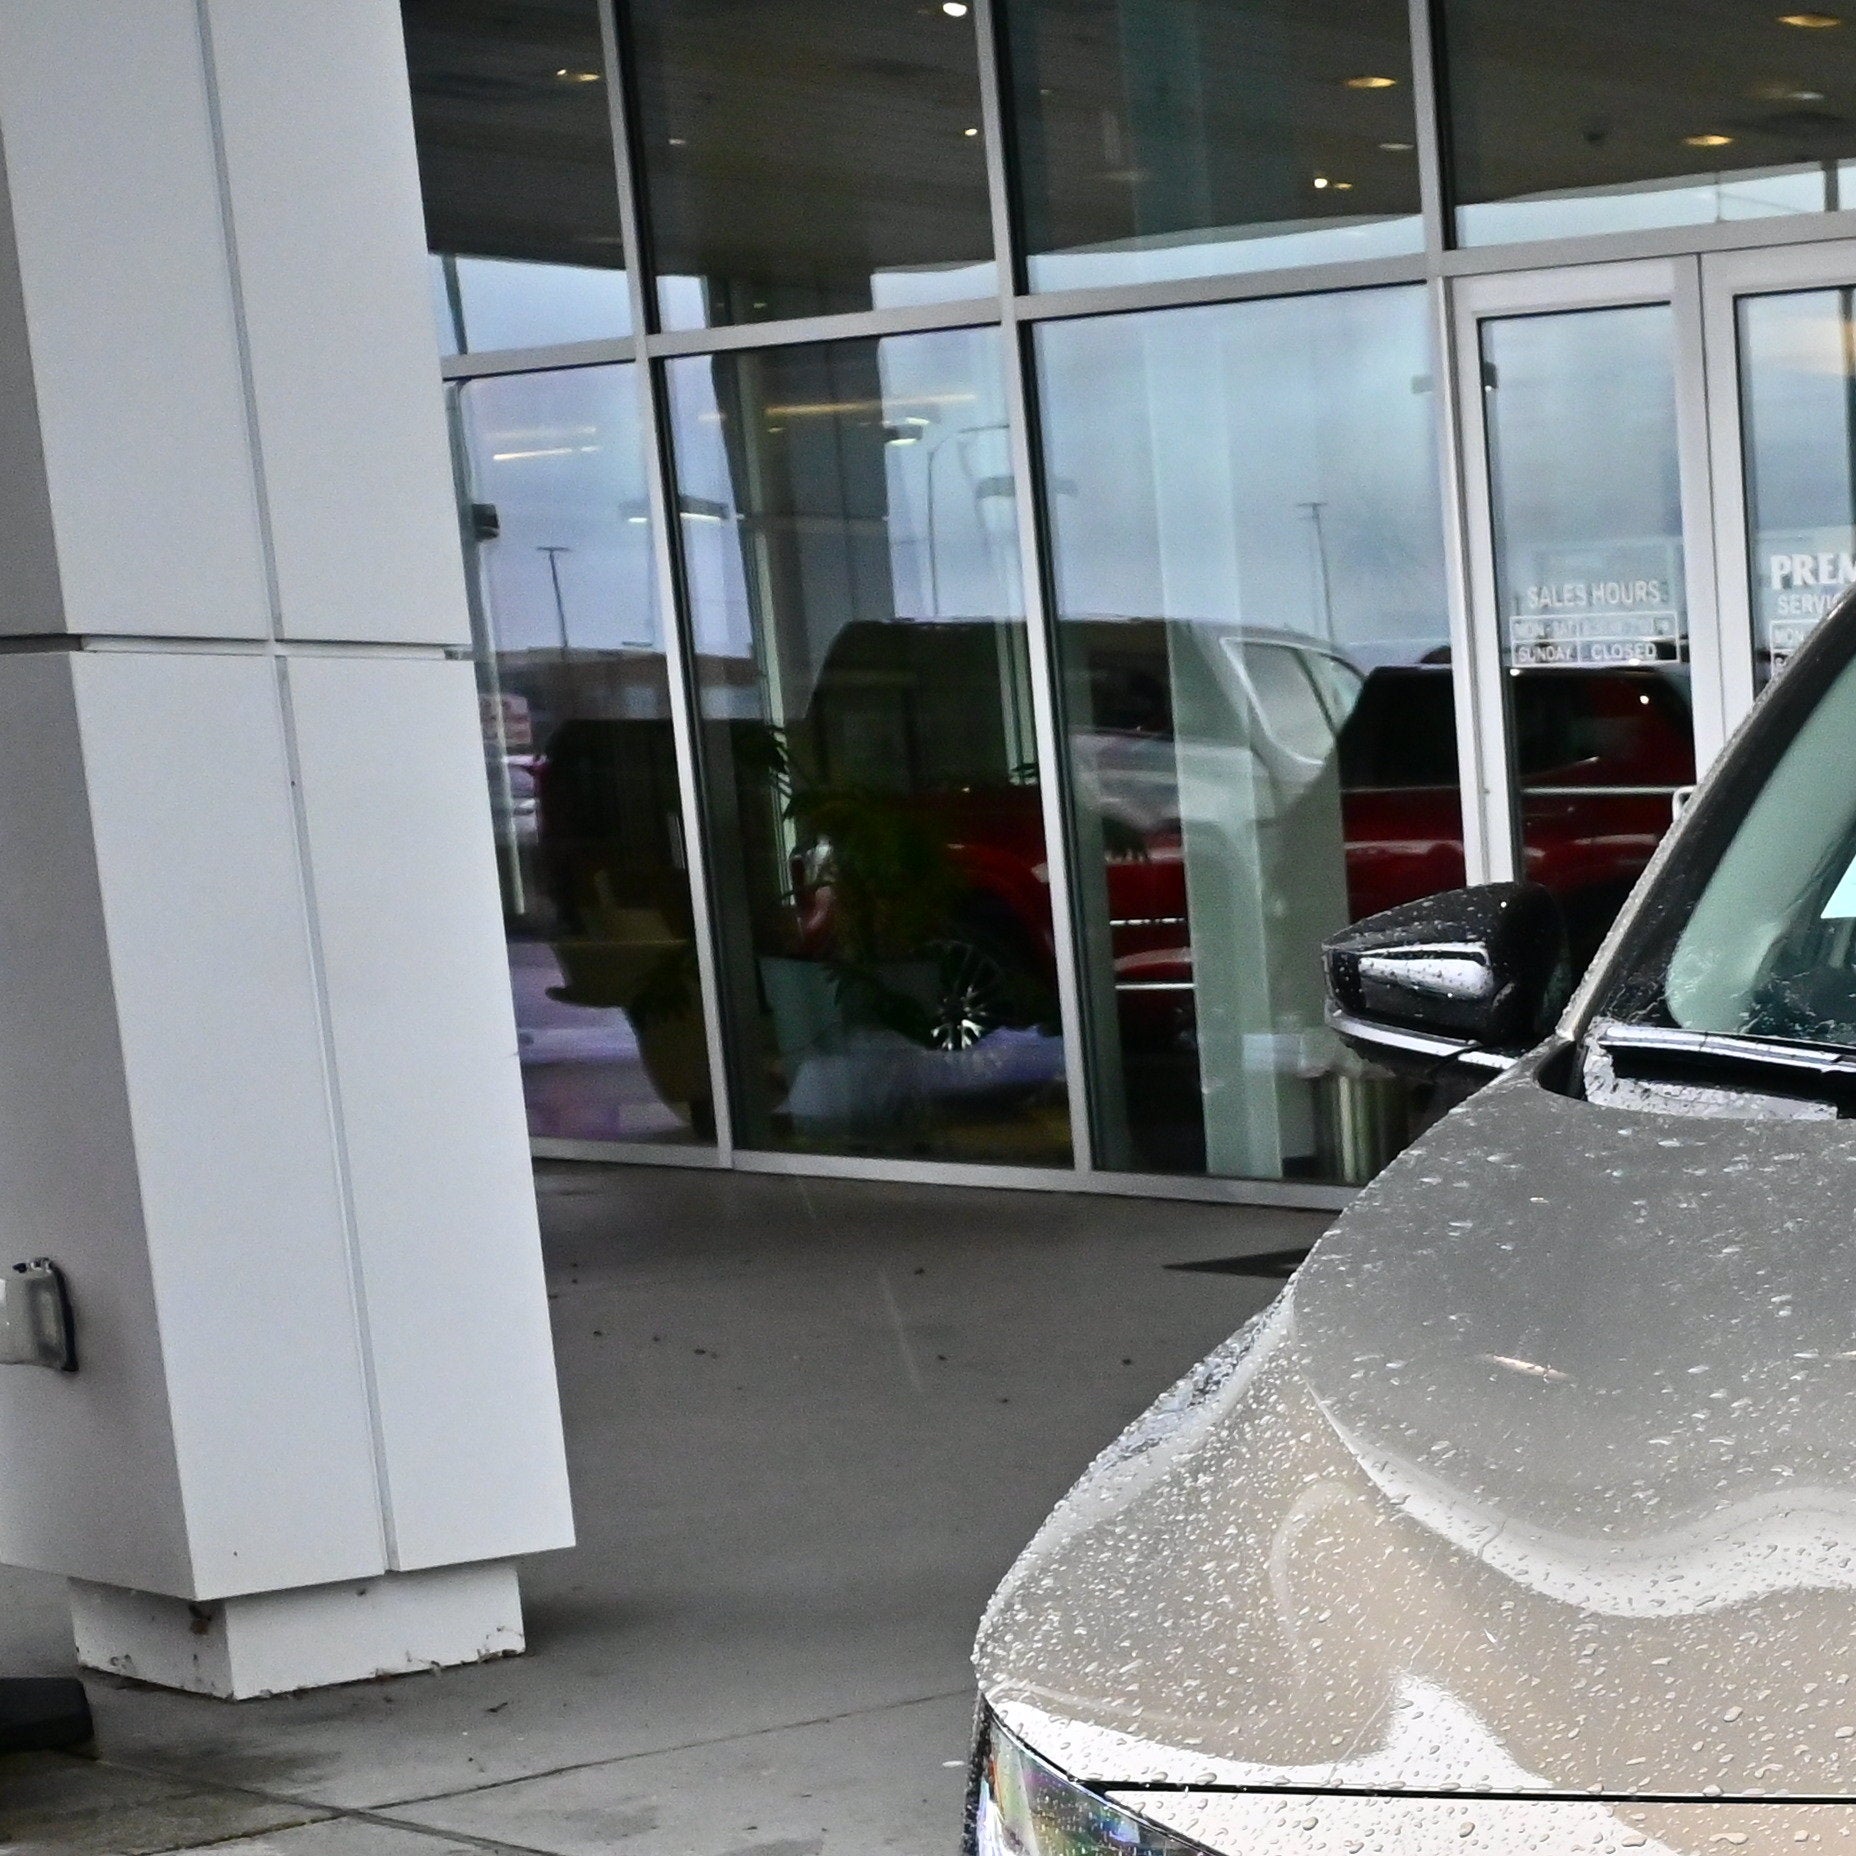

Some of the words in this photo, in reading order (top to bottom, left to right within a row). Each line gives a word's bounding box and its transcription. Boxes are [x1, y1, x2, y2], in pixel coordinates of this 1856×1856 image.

[1527, 583, 1587, 608] SALES
[1592, 580, 1661, 606] HOURS
[1517, 645, 1572, 663] SUNDAY
[1591, 643, 1657, 661] CLOSED
